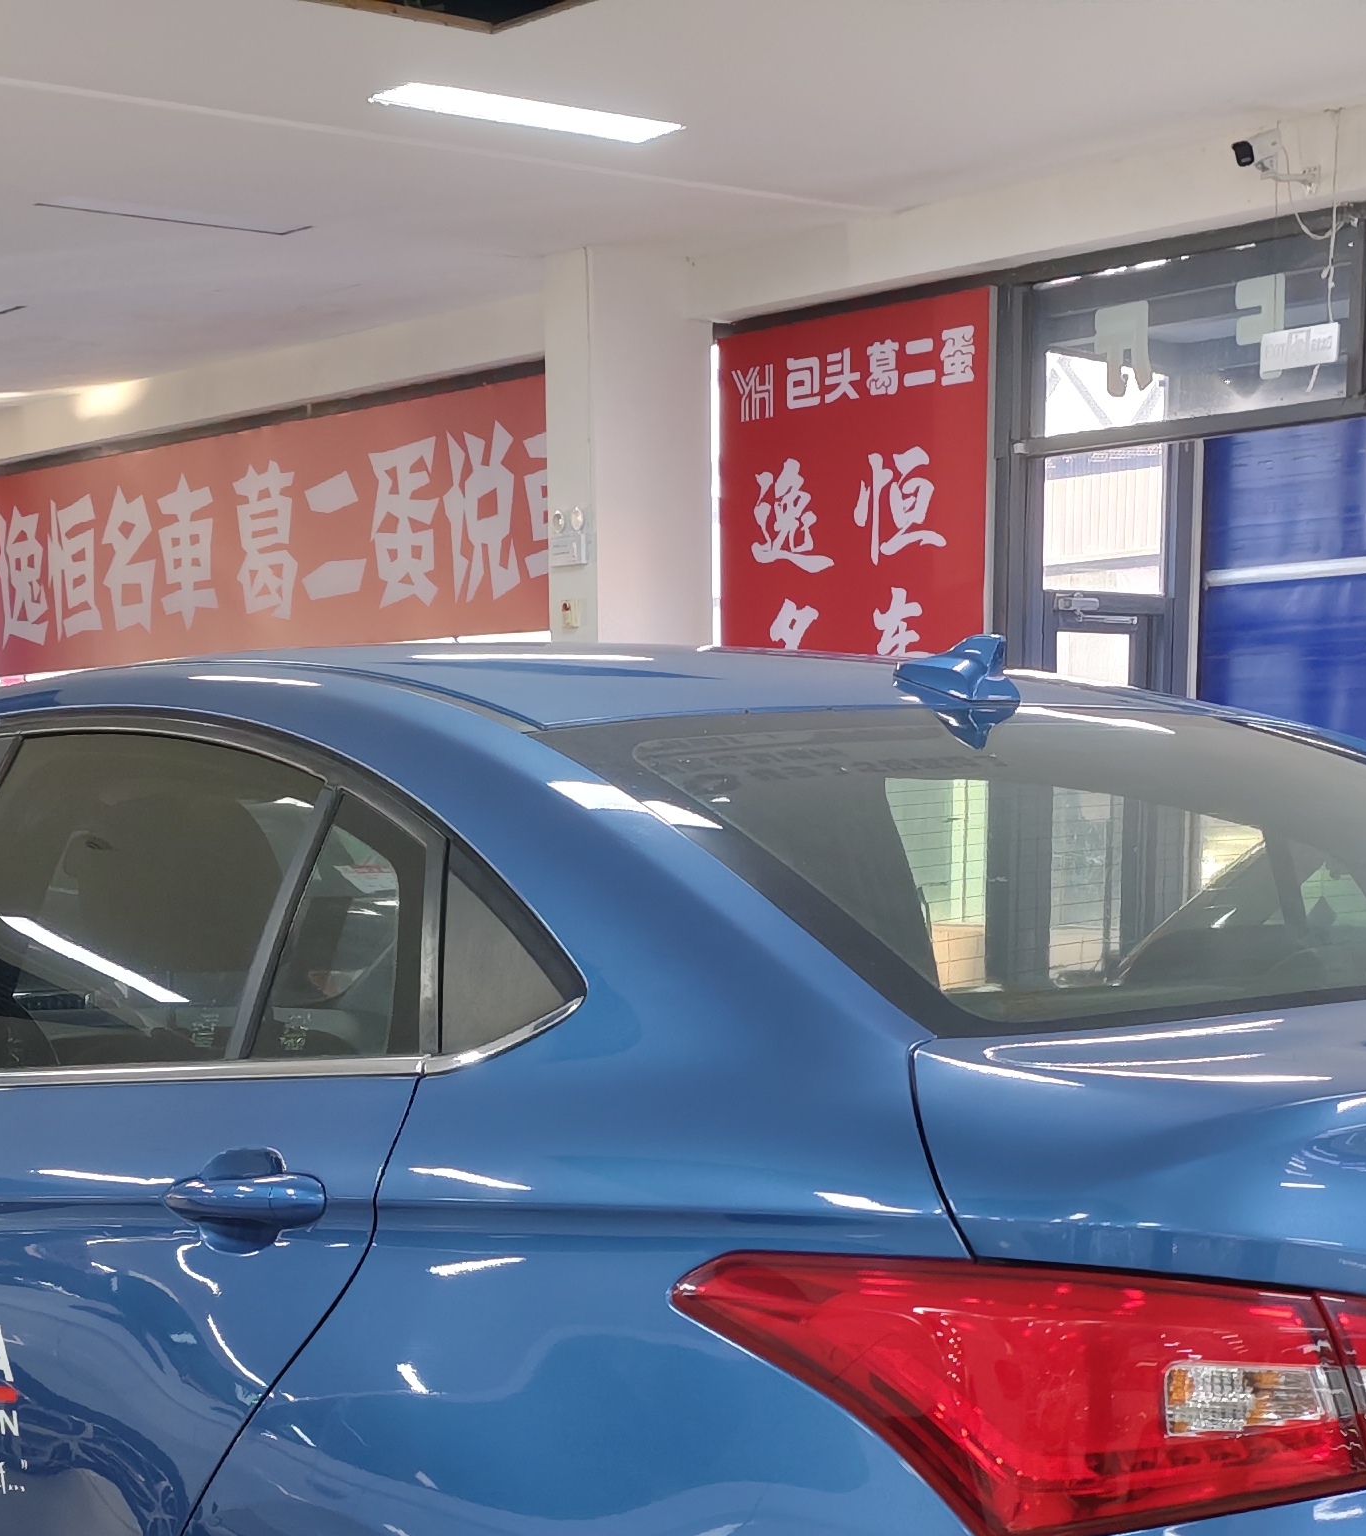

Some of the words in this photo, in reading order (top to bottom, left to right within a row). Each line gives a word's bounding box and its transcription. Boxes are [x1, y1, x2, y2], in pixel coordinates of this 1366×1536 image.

[787, 325, 975, 410] 包头葛二蛋
